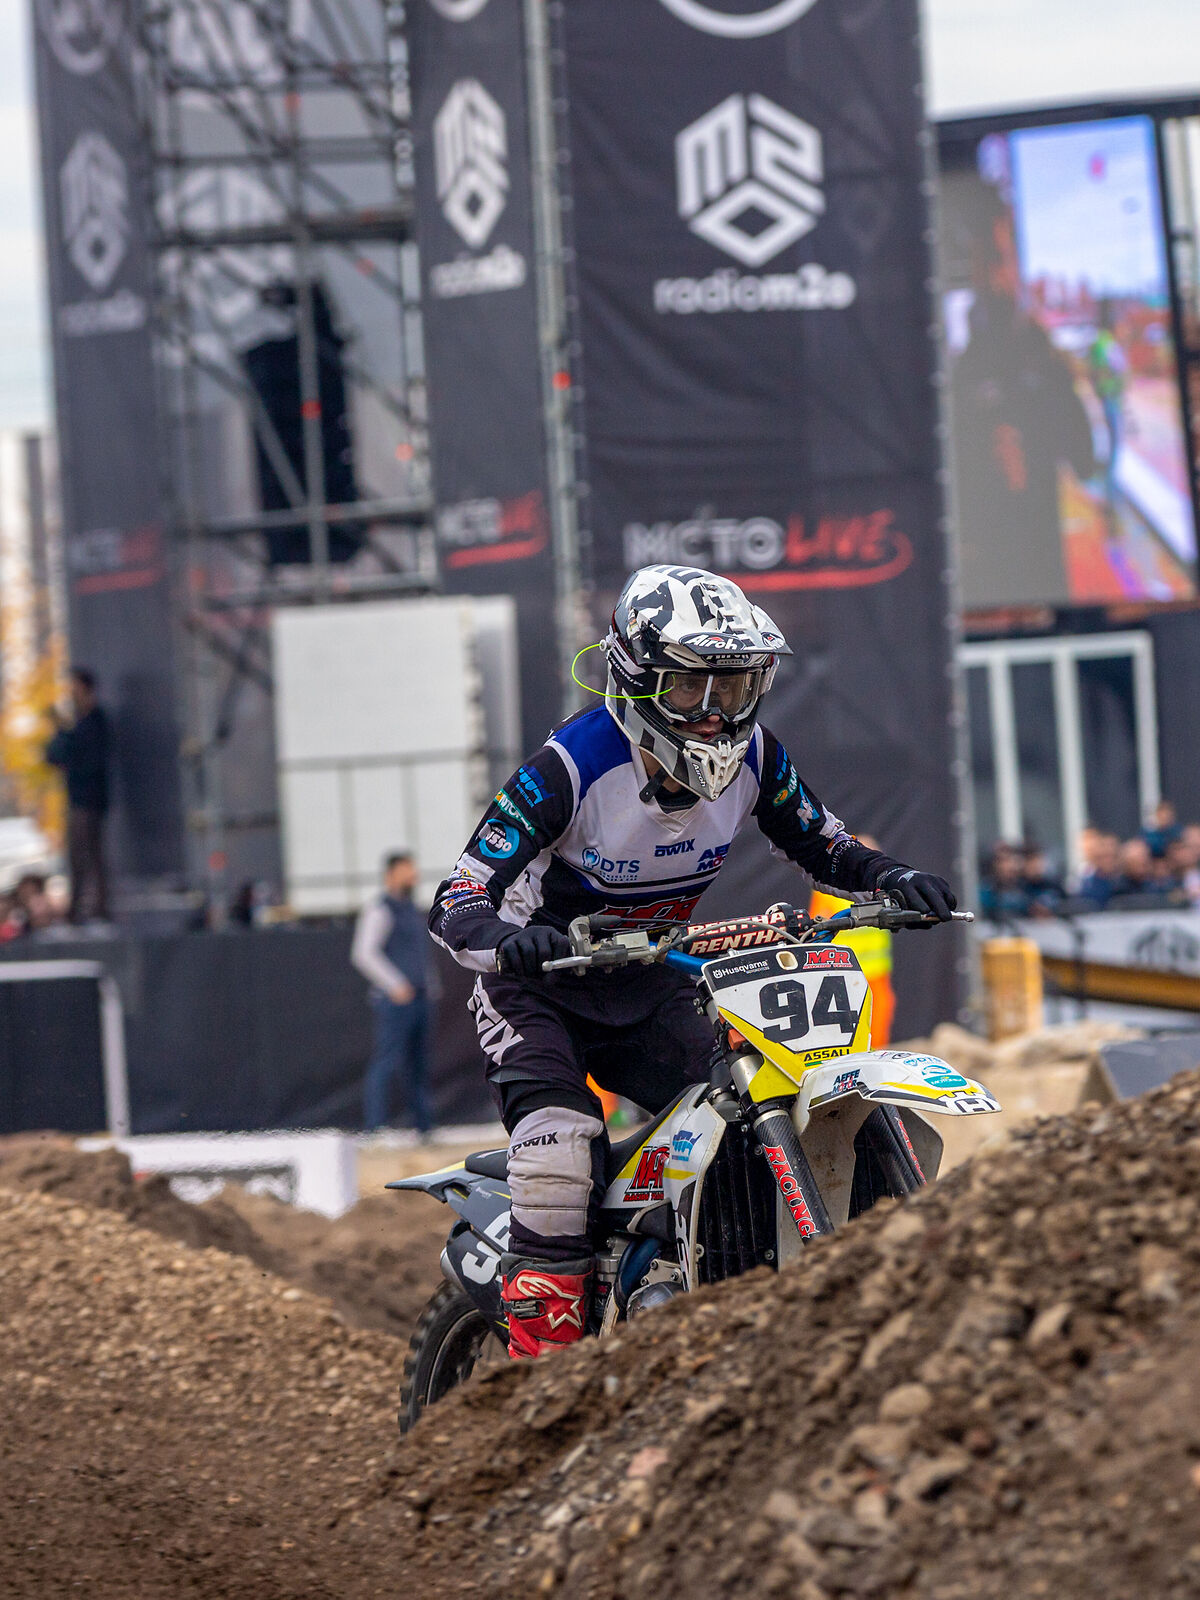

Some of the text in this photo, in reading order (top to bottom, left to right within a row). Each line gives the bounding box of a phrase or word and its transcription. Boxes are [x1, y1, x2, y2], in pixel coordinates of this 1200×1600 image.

[685, 634, 738, 650] Airoh
[692, 762, 707, 787] Airoh
[600, 857, 641, 874] DTS
[688, 924, 790, 956] RENTHA
[806, 948, 851, 965] MCR
[722, 960, 768, 977] Husqvarna
[759, 976, 859, 1044] 94
[762, 1143, 820, 1239] RACING
